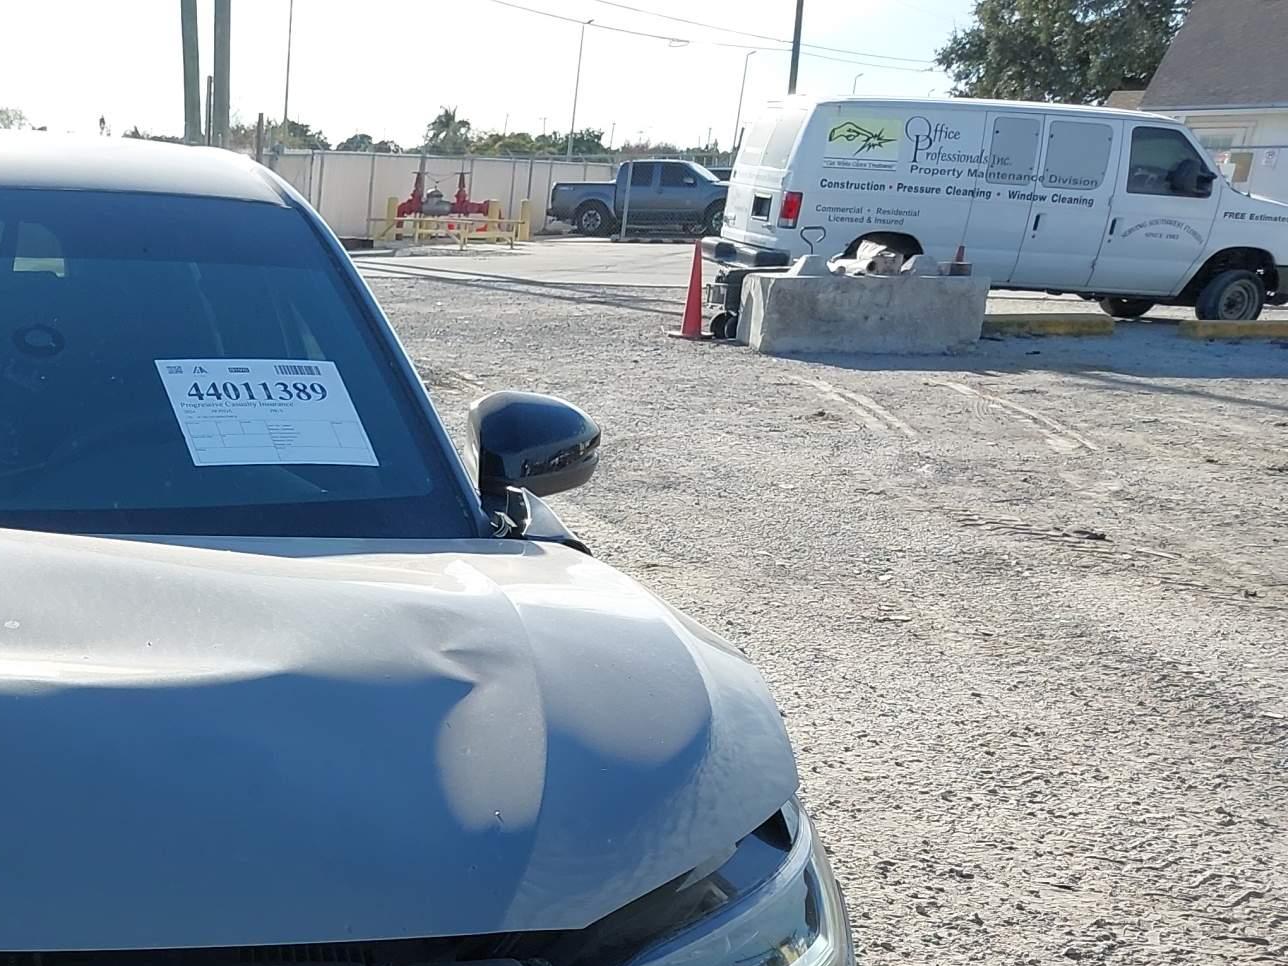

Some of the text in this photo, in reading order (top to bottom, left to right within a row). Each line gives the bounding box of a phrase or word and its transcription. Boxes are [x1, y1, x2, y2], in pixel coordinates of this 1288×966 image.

[905, 116, 961, 143] Office
[911, 134, 1012, 168] Professionals Inc.
[910, 165, 1099, 188] Property Maintenance Division
[820, 179, 1094, 207] Construction Pressure Cleaning Window Cleaning
[816, 205, 920, 217] Commercial Residential
[828, 215, 864, 223] Licensed
[874, 217, 904, 225] Insured
[1223, 211, 1247, 220] FREE
[188, 382, 327, 402] 44011389
